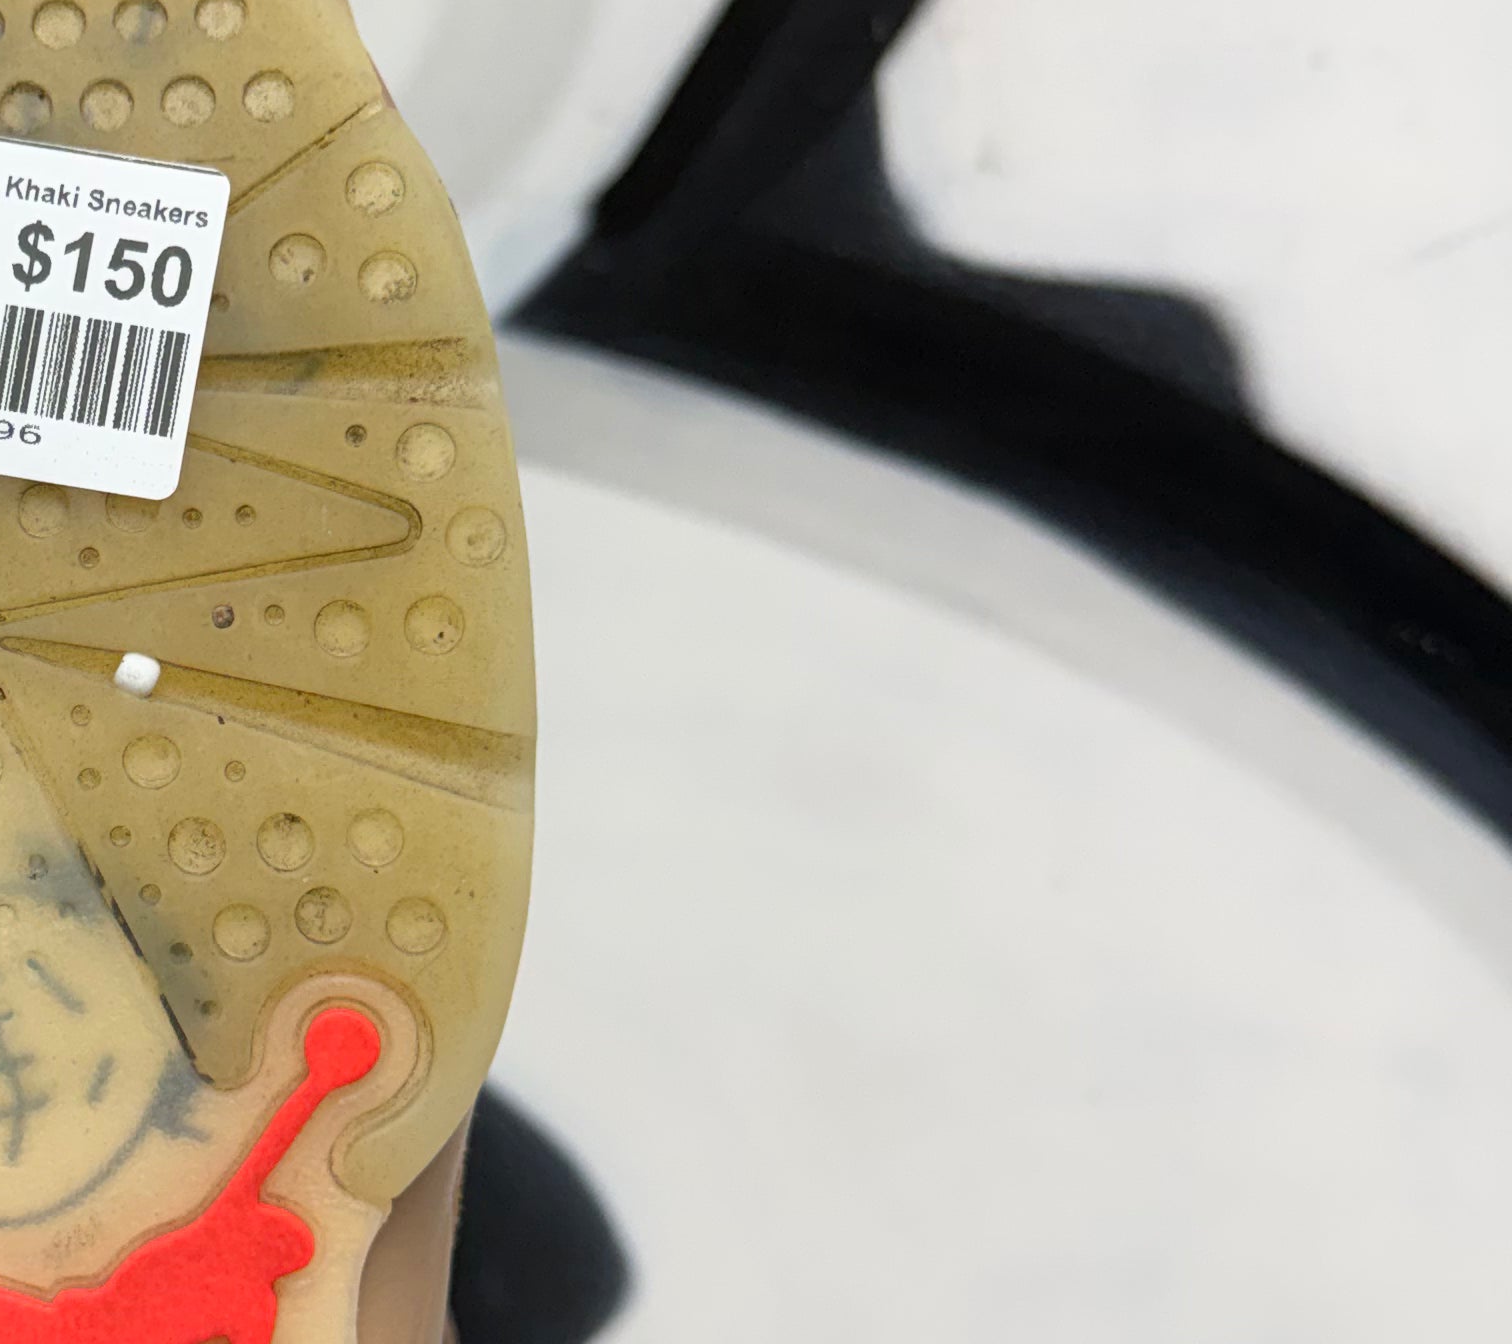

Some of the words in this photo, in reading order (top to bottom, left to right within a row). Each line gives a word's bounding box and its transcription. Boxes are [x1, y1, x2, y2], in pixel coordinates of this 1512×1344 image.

[5, 175, 80, 209] Khaki
[87, 189, 209, 229] Sneakers
[11, 219, 192, 308] $150
